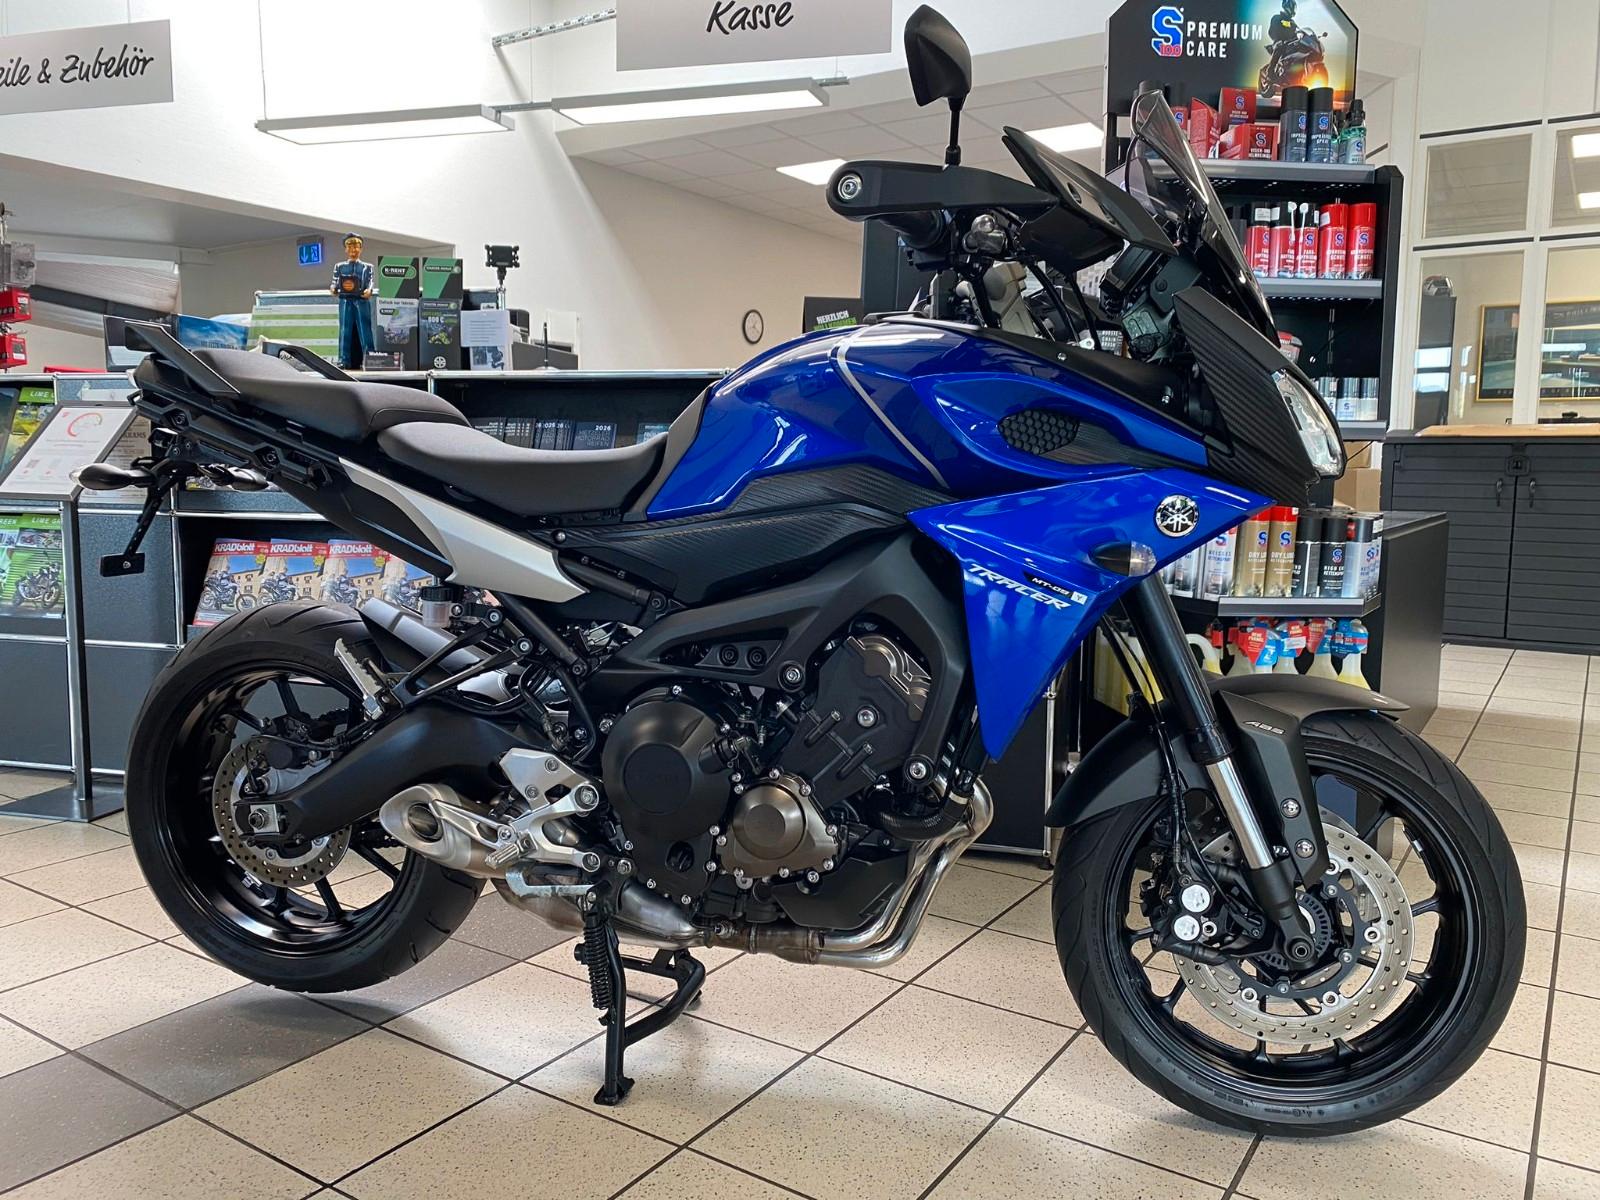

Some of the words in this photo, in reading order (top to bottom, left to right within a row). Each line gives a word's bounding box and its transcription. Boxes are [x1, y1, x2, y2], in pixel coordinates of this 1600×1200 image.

[706, 0, 794, 35] Kasse
[1186, 21, 1263, 40] PREMIUM
[1186, 41, 1227, 58] CARE
[37, 57, 51, 84] &
[60, 44, 154, 84] Zubehör
[816, 310, 850, 325] HERZLICH
[214, 542, 256, 552] KRADblatt
[270, 543, 313, 553] KRADblatt
[1280, 531, 1292, 548] S
[329, 543, 373, 555] KRADblatt
[968, 563, 1072, 610] TRACER
[1031, 577, 1070, 596] MT-09
[1243, 720, 1285, 735] ABS
